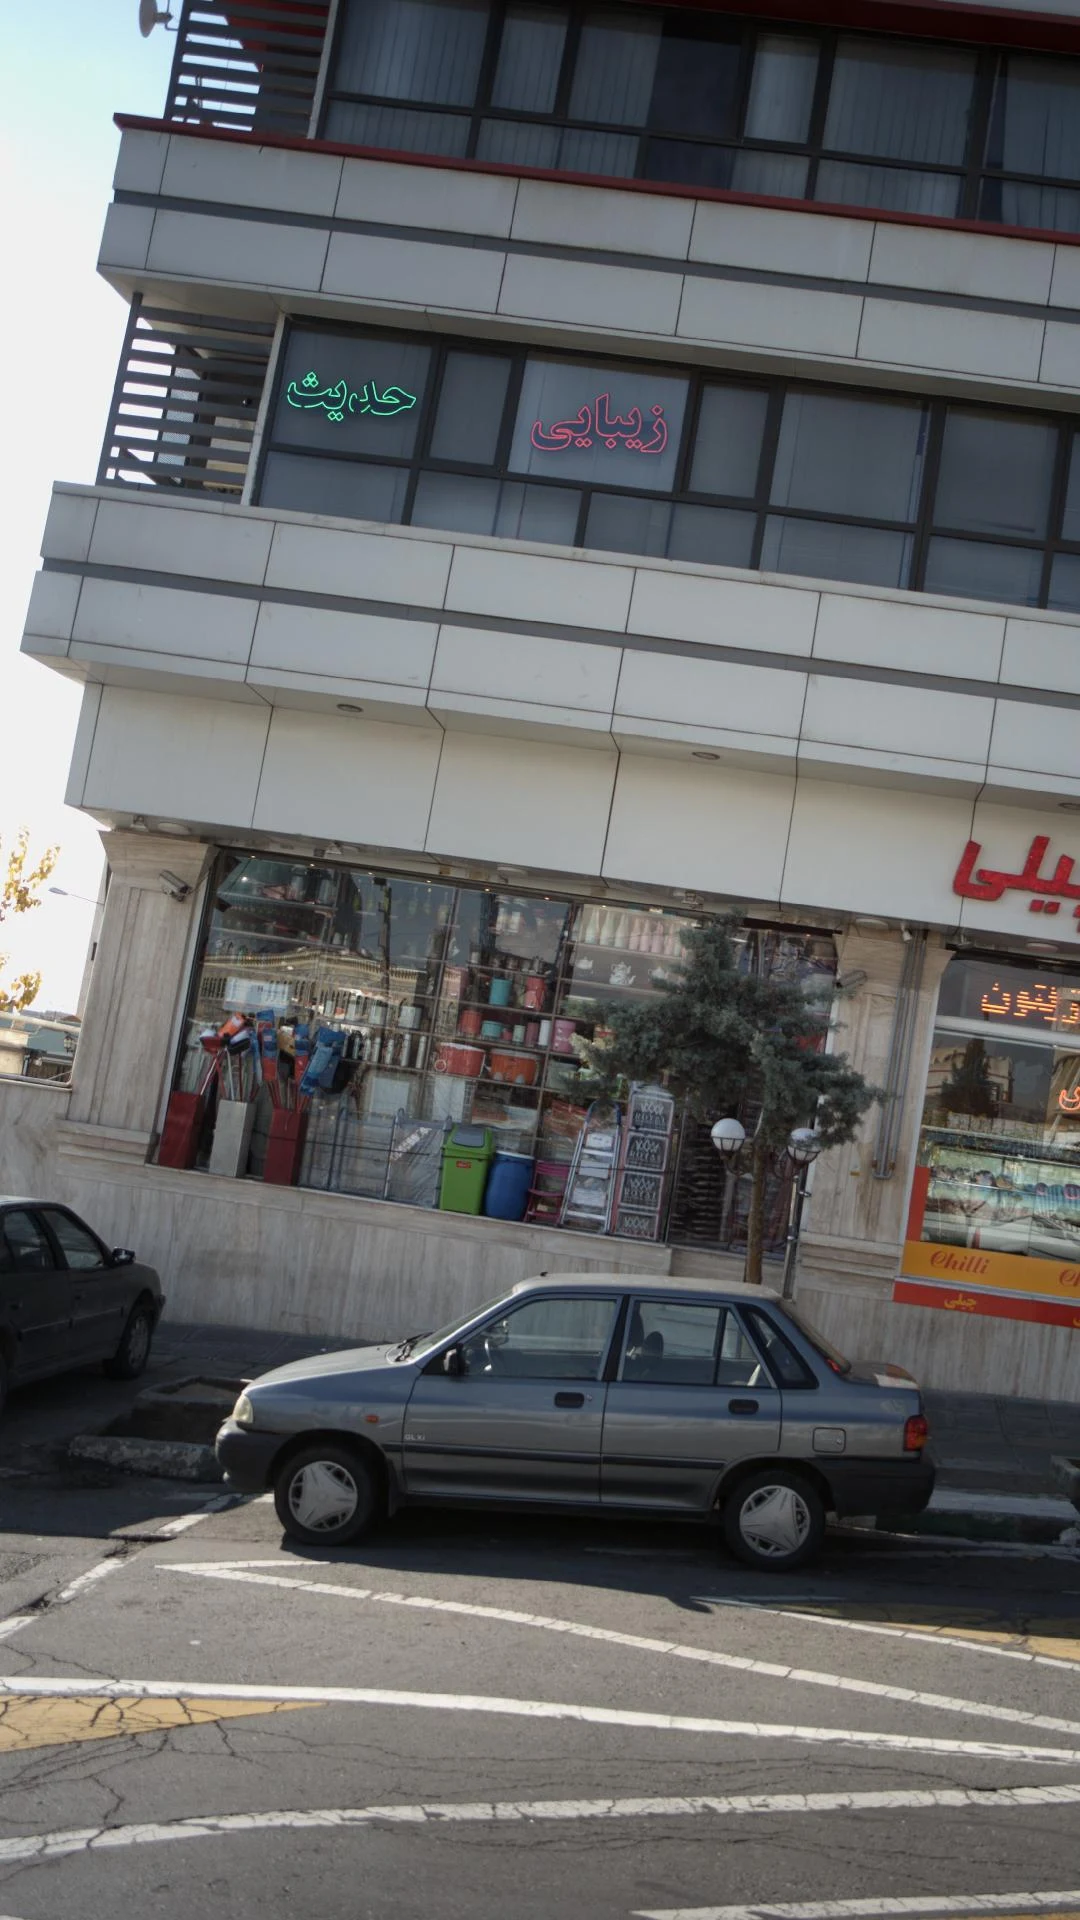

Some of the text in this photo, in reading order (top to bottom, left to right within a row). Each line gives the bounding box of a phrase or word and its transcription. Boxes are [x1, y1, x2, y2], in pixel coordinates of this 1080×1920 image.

[531, 393, 668, 454] زیبایی
[953, 835, 1080, 933] یلی
[929, 1250, 991, 1275] Chilli
[943, 1292, 978, 1312] چیلی
